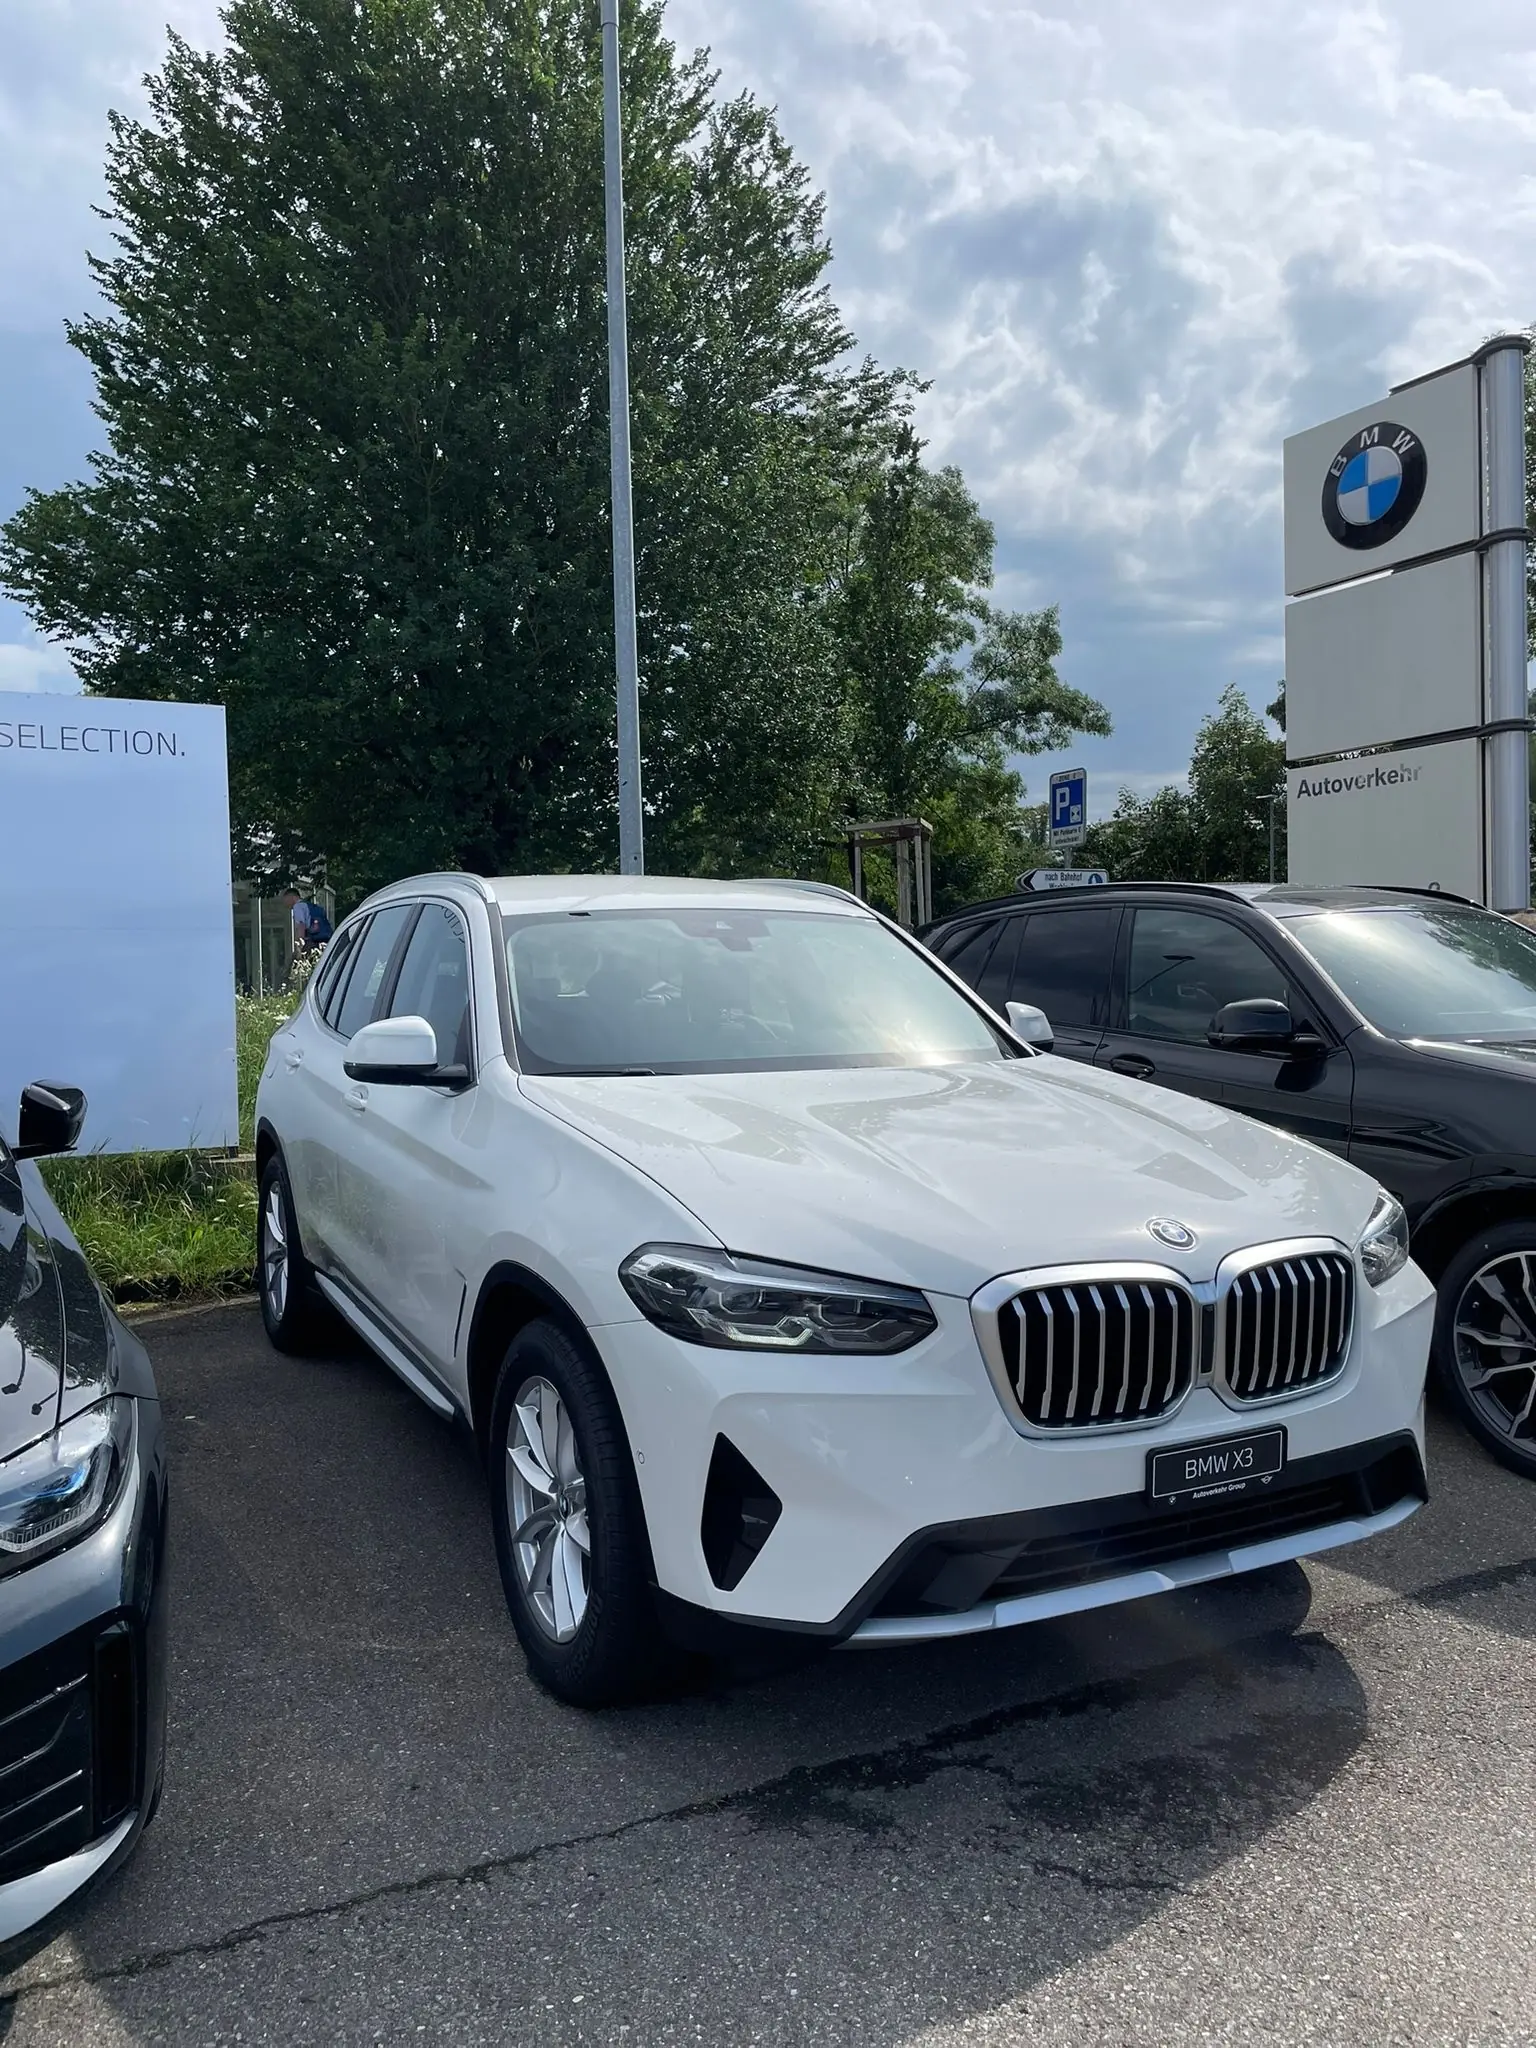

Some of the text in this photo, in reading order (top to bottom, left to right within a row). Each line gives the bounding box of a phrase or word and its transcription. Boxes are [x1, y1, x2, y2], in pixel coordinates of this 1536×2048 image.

[1330, 426, 1415, 477] BMW
[0, 722, 186, 757] SELECTION.
[1296, 763, 1422, 799] Autoverkehr
[1055, 786, 1070, 821] P
[1045, 872, 1083, 881] nach Bahnhof
[1185, 1447, 1254, 1479] BMW X3
[1192, 1482, 1247, 1499] Autoverkehr Group
